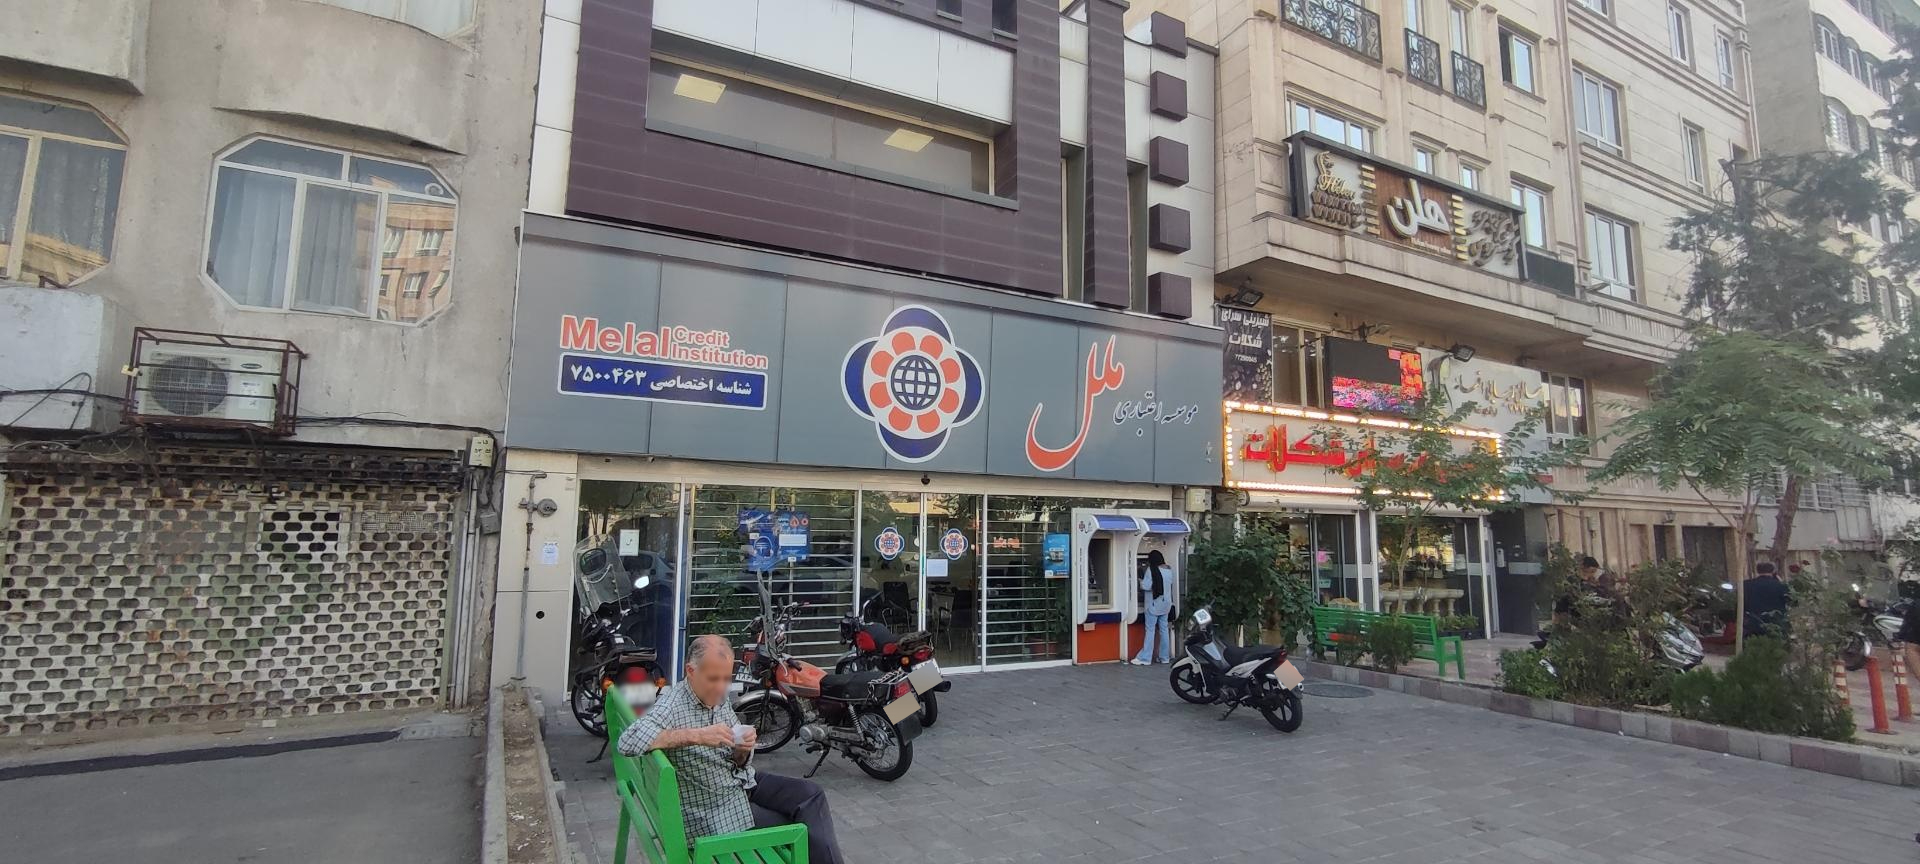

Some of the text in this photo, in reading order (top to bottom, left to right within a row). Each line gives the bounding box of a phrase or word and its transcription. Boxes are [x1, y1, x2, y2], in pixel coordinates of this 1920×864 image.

[1386, 178, 1450, 237] هلن
[1221, 307, 1270, 329] شیرینی سرای
[560, 314, 672, 359] Melal
[673, 325, 730, 347] Credit
[1229, 332, 1262, 349] شکلات
[671, 342, 769, 369] Institution
[570, 363, 752, 396] شناسه اختصاصی ۷۵۰۰۴۶۳
[1026, 335, 1125, 471] ملل
[1113, 391, 1163, 436] اعتباری
